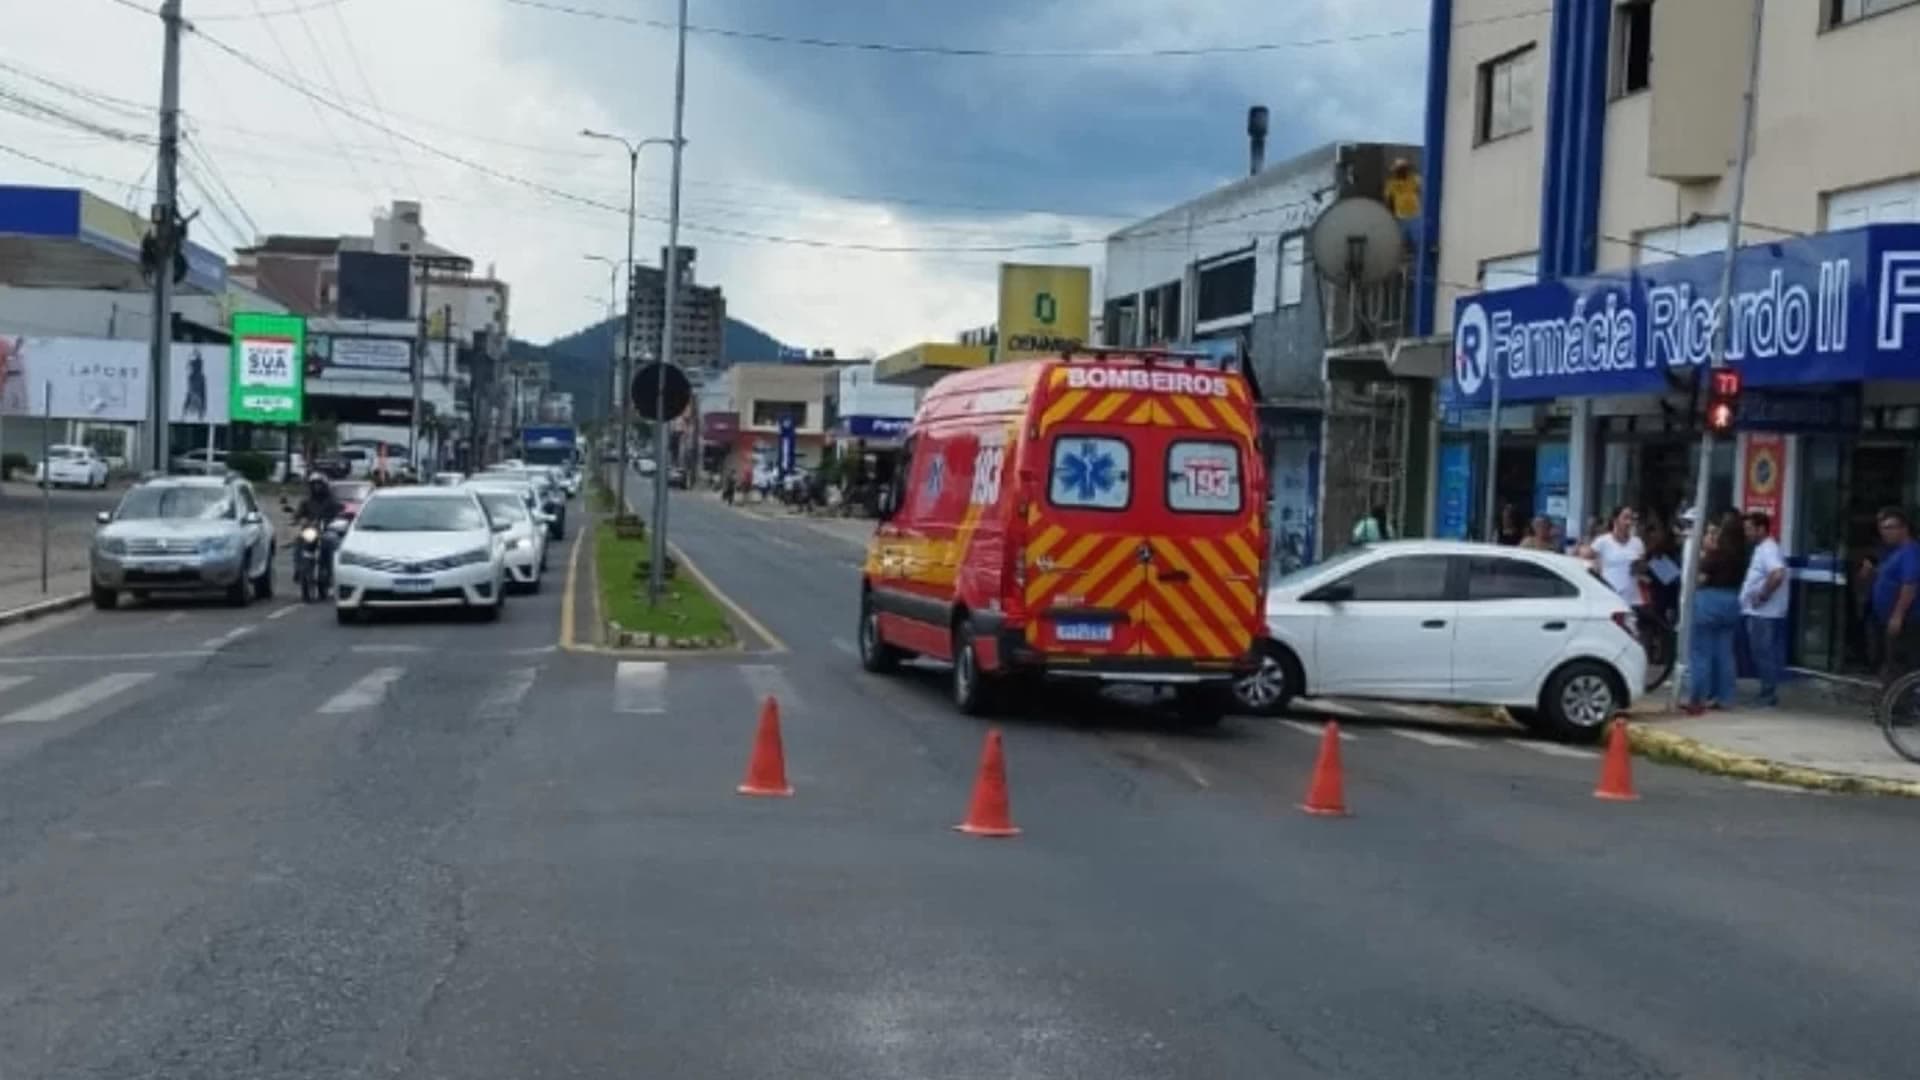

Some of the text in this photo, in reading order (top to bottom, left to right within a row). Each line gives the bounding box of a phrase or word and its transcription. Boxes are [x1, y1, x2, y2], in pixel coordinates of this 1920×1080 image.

[1489, 293, 1637, 379] Farmácia
[248, 353, 286, 369] SUA
[1068, 367, 1228, 397] BOMBEIROS
[1187, 467, 1229, 497] 193
